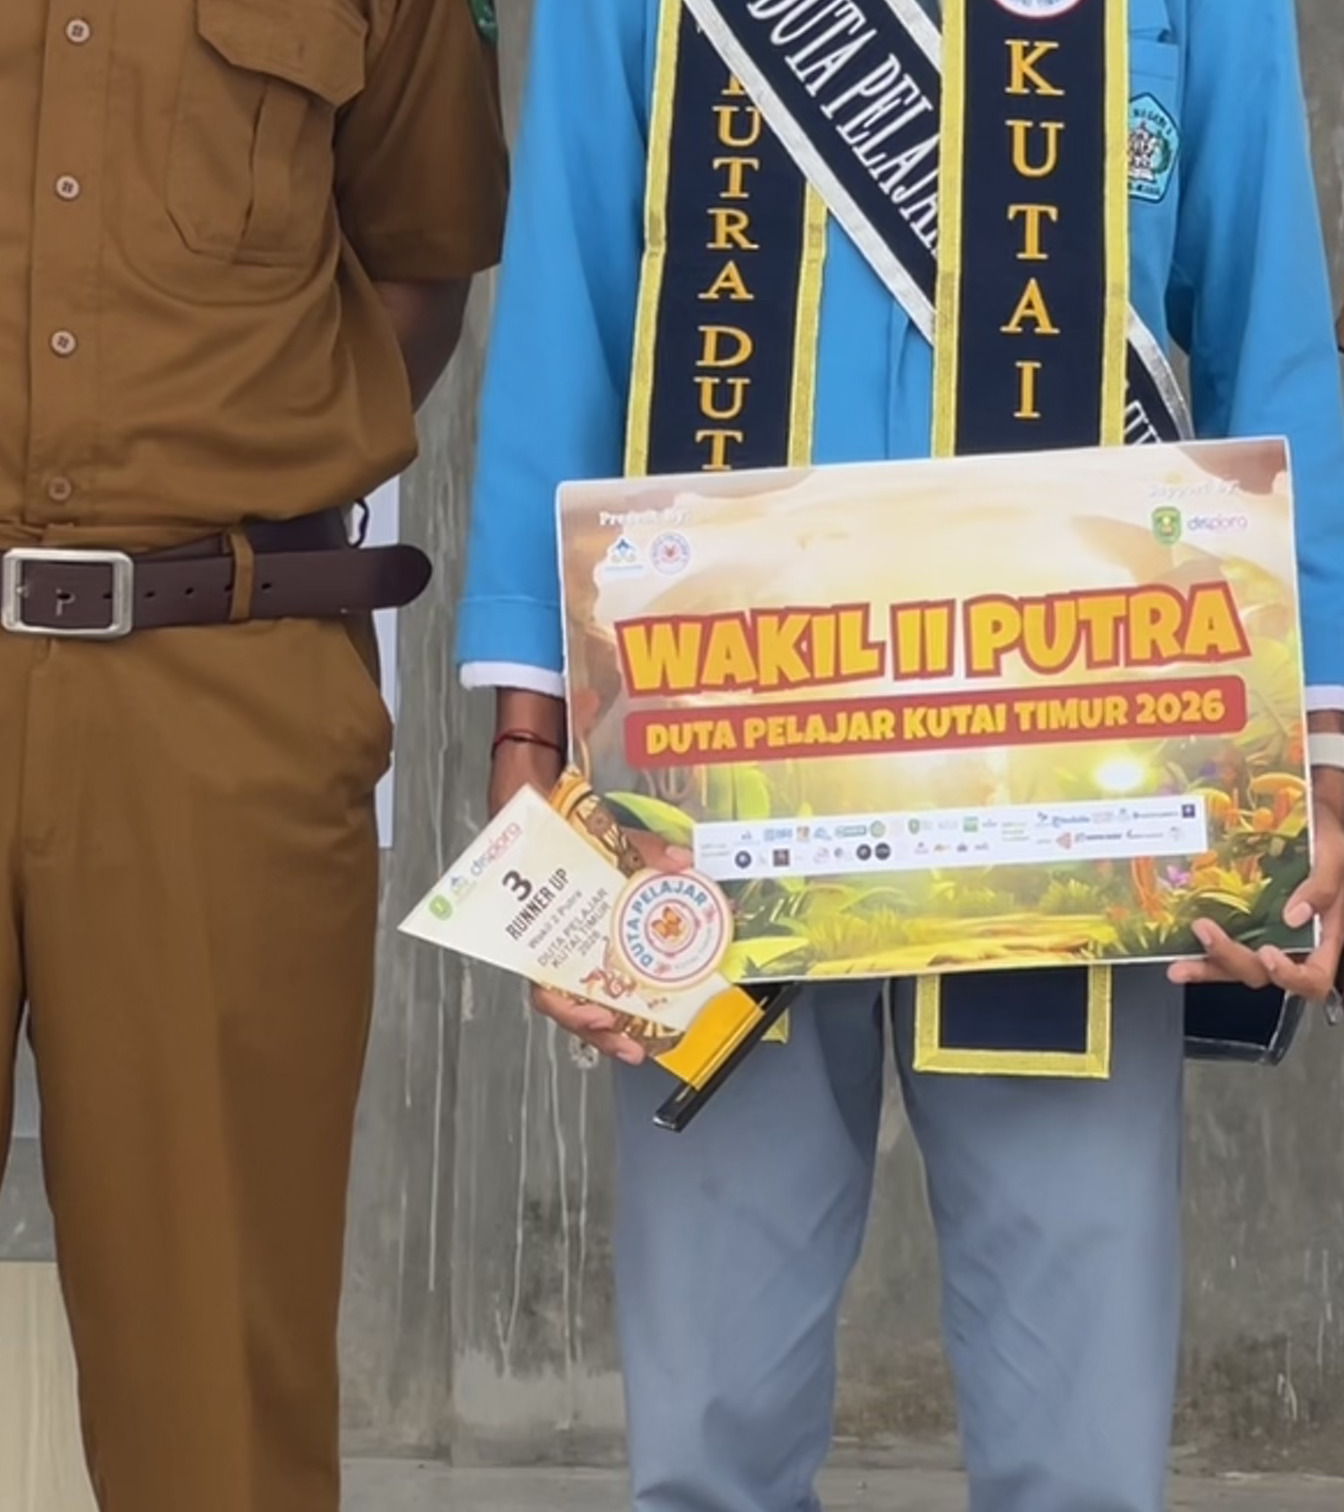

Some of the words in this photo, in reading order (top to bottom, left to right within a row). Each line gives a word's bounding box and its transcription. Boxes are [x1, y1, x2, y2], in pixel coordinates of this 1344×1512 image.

[821, 53, 941, 260] PELAJA
[1000, 39, 1065, 418] KUTAI
[618, 604, 884, 696] WAKIL
[892, 600, 956, 680] II
[964, 583, 1250, 678] PUTRA
[645, 718, 737, 755] DUTA
[745, 707, 895, 748] PELAJAR
[903, 704, 1006, 740] KUTAI
[1014, 695, 1128, 731] TIMUR
[1136, 689, 1225, 724] 2026
[502, 869, 533, 902] 3
[505, 885, 555, 940] RUNNER
[548, 867, 572, 892] UP
[632, 880, 708, 915] PELAJAR
[537, 934, 567, 967] DUTA
[562, 888, 608, 938] PELAJAR
[627, 918, 654, 968] DUTA
